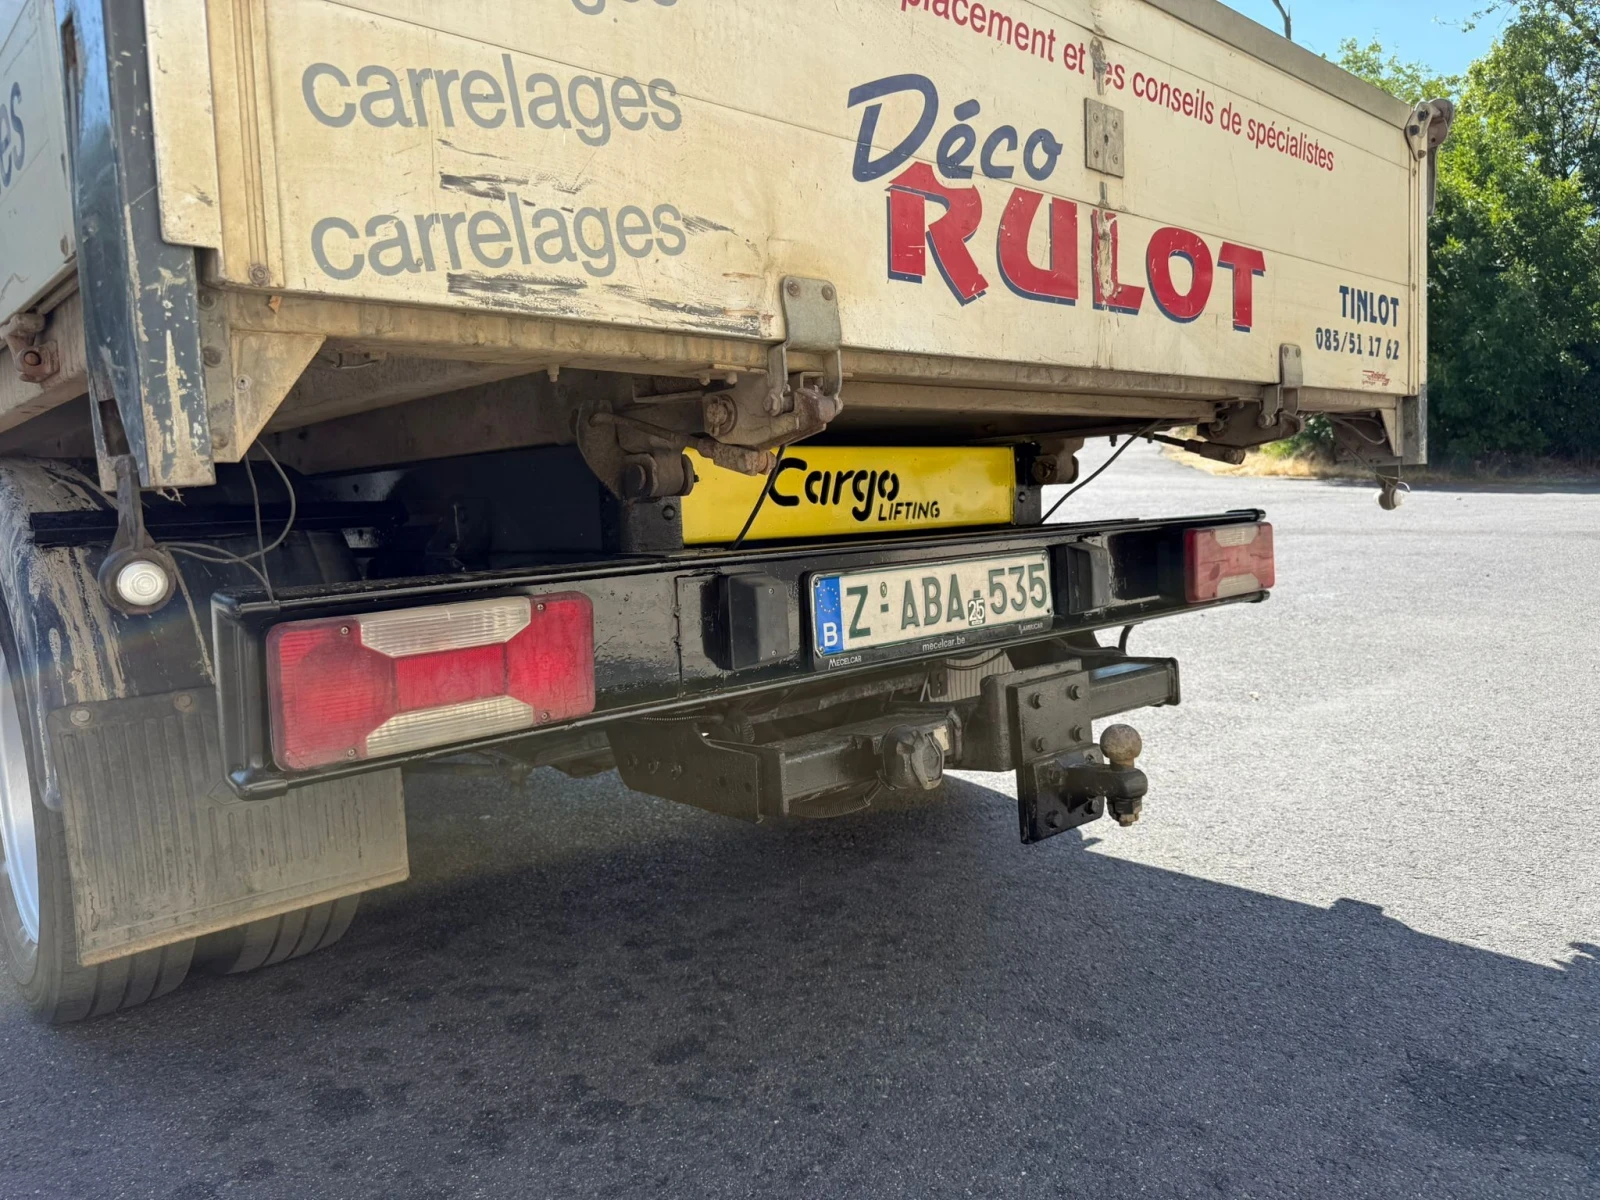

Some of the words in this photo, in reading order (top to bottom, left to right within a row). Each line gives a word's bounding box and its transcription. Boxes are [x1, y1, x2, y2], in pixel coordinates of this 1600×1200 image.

[301, 53, 683, 147] carrelages
[1063, 42, 1086, 75] et
[1132, 71, 1214, 125] conseils
[1220, 102, 1242, 136] de
[1246, 118, 1335, 172] spécialistes
[846, 73, 1064, 183] Déco
[310, 191, 687, 278] carrelages
[885, 161, 1266, 333] RULOT
[1338, 284, 1400, 328] TINLOT
[1315, 327, 1363, 356] 085/51
[1368, 335, 1382, 358] 17
[1386, 339, 1400, 361] 62
[766, 457, 900, 522] Cargo
[877, 501, 941, 522] LIFTING
[822, 622, 839, 647] B
[968, 599, 986, 622] 25
[922, 635, 966, 652] mecelcar.be
